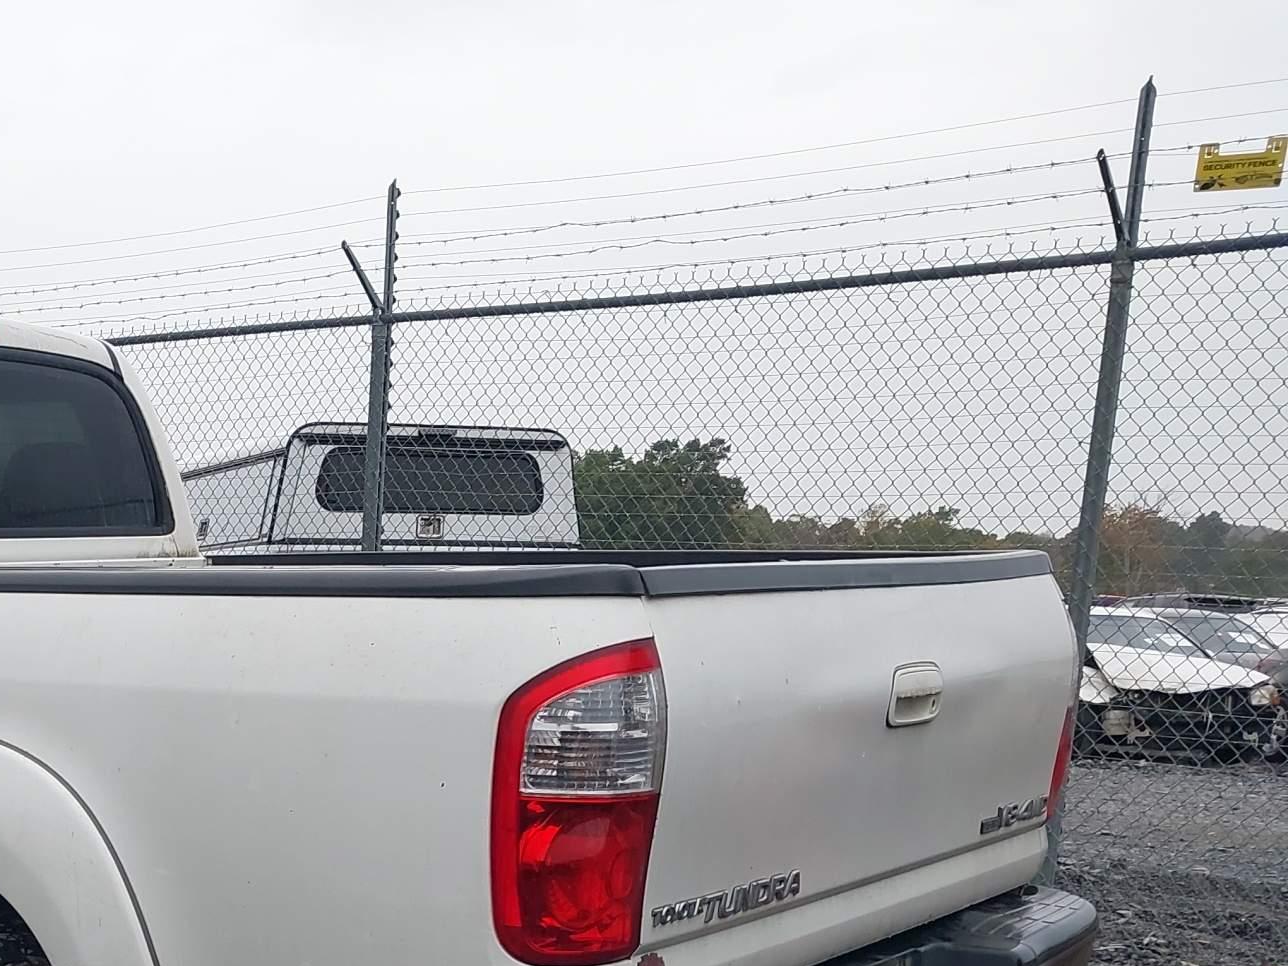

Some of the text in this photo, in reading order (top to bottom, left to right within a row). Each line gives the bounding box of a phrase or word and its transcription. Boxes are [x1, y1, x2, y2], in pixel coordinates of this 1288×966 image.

[1202, 161, 1247, 172] SECURITY
[1247, 159, 1278, 169] FENCE
[702, 869, 801, 923] TUNDRA
